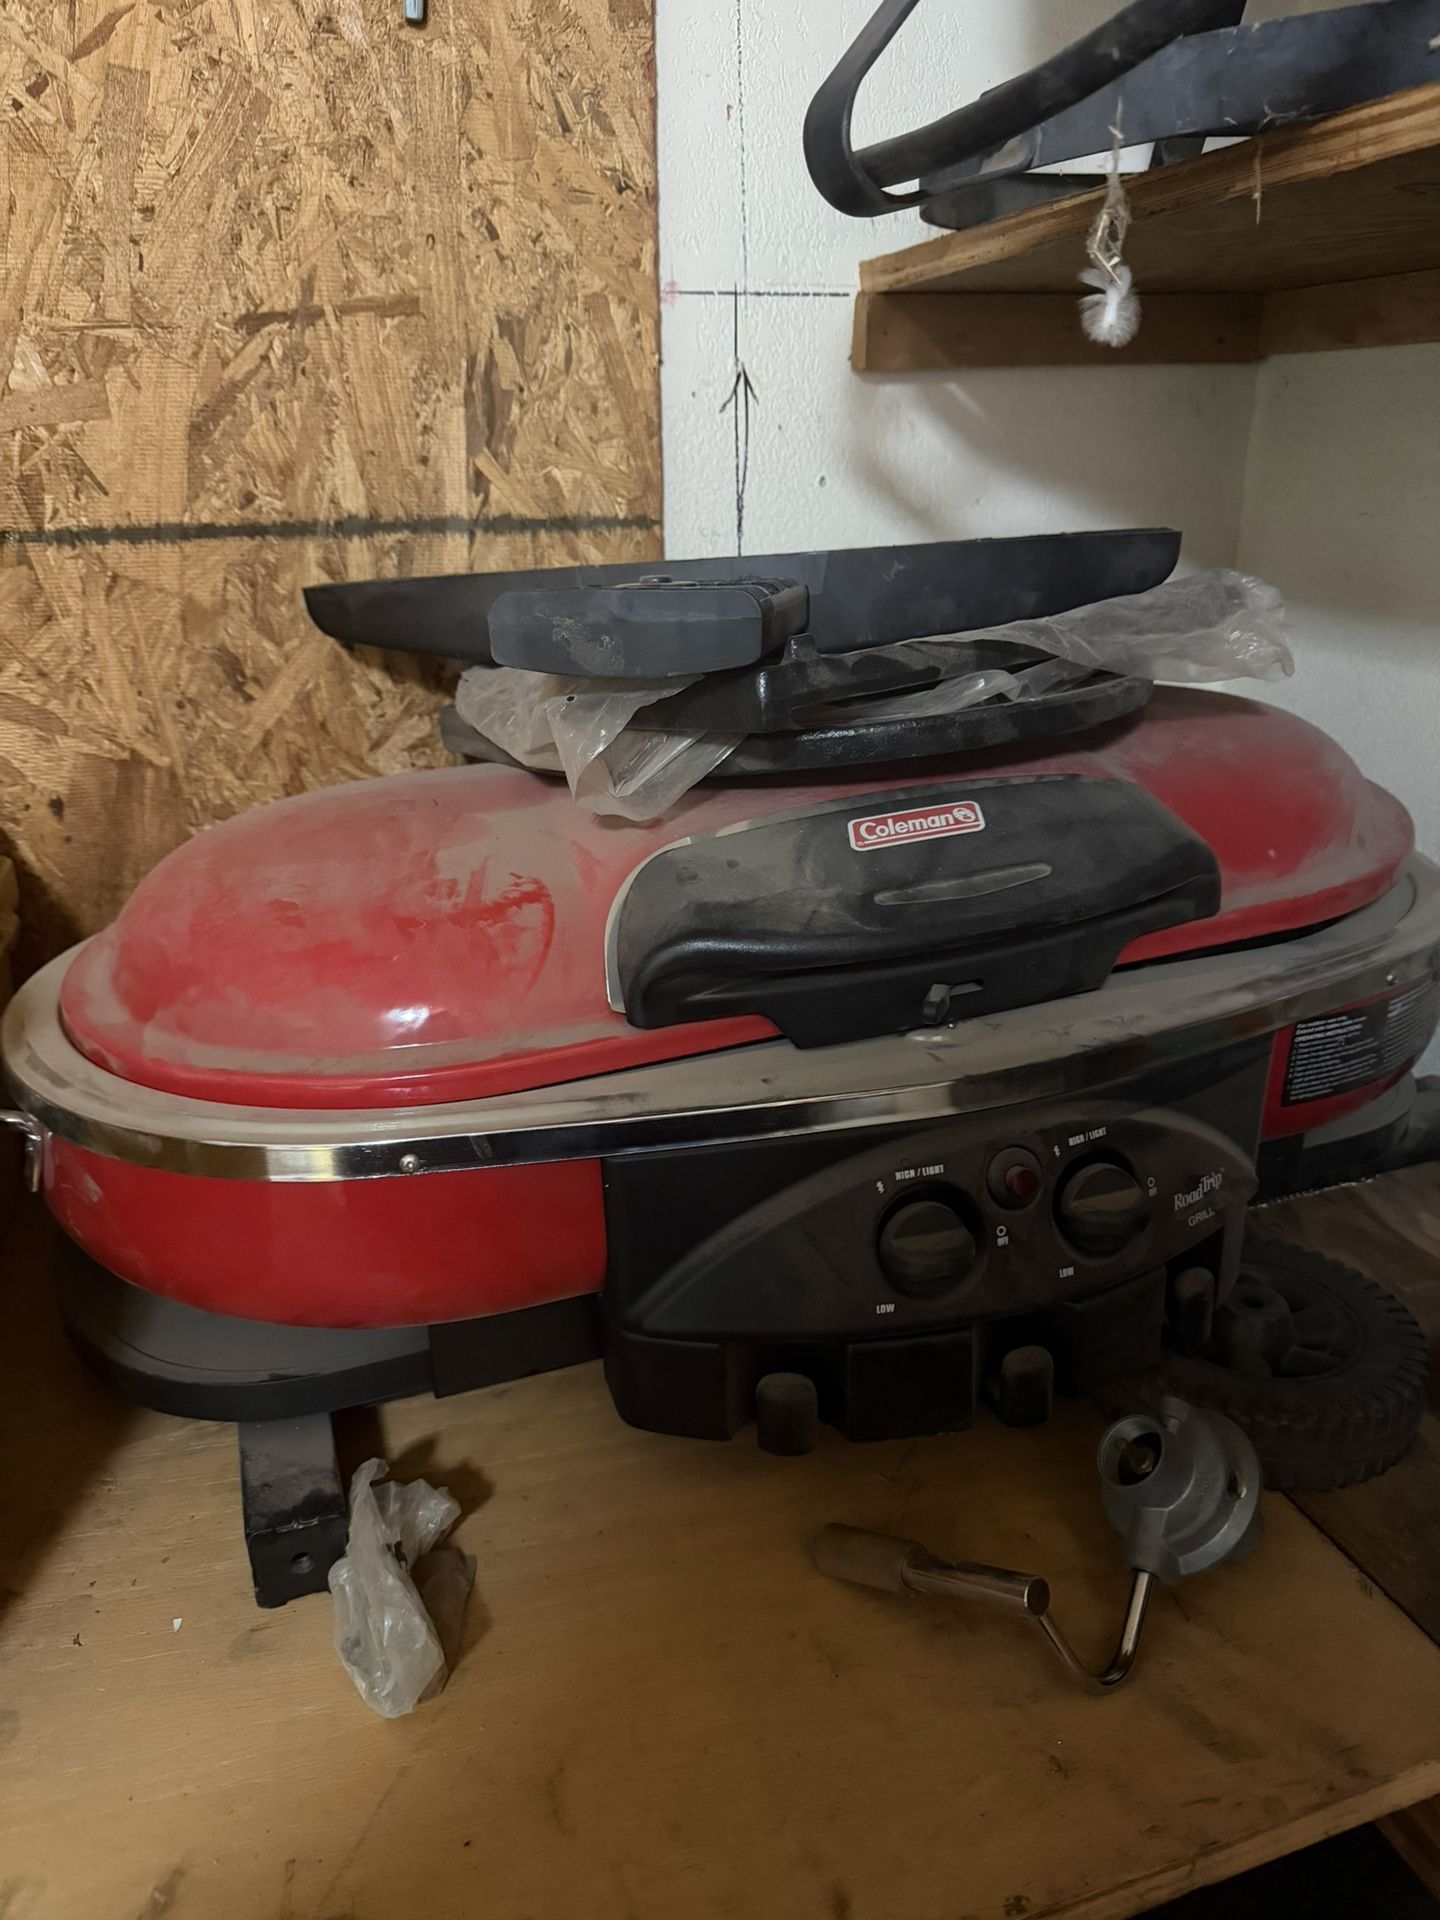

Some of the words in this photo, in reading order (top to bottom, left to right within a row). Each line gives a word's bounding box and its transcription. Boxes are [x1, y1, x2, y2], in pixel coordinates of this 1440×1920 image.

[859, 813, 955, 840] Coleman
[895, 1168, 916, 1181] HIGH
[922, 1163, 945, 1176] LIGHT
[1188, 1206, 1216, 1227] GRILL
[1059, 1266, 1075, 1279] LOW
[876, 1303, 895, 1314] LOW
